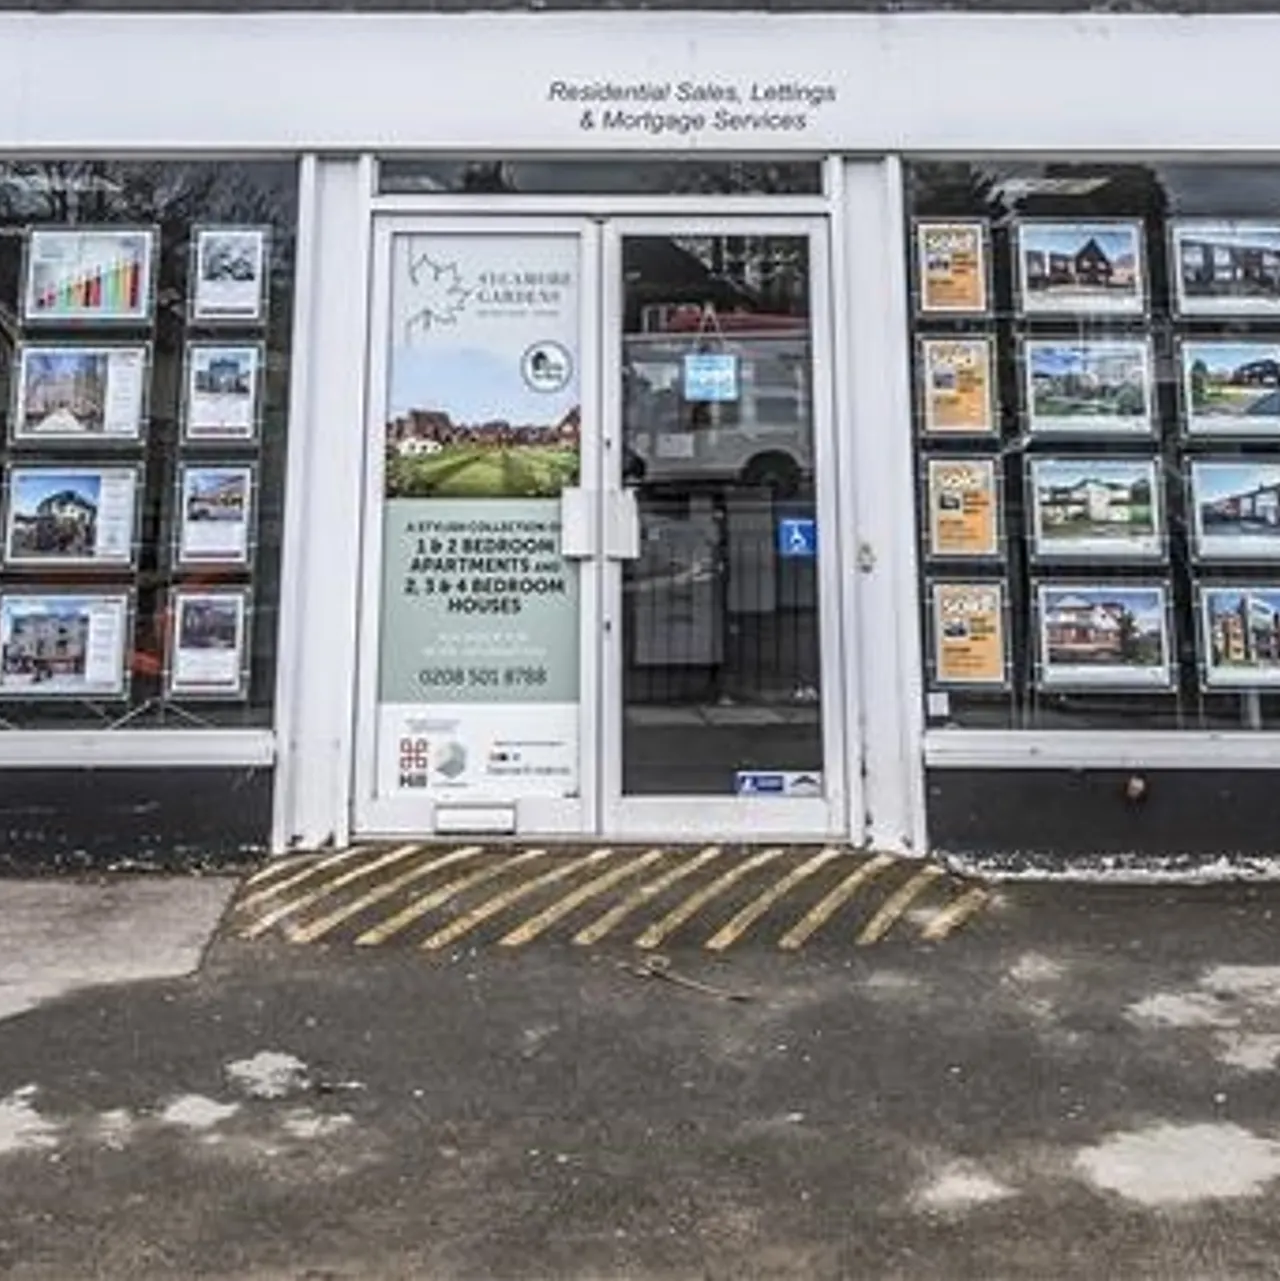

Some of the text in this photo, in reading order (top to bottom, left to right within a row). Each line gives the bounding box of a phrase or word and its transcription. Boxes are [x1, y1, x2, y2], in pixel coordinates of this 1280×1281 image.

[548, 80, 837, 106] Residential Sales, Lettings
[580, 109, 807, 134] & Mortgage Services
[462, 538, 556, 554] BEDROOM
[410, 557, 530, 573] APARTMENTS
[471, 577, 565, 594] BEDROOM
[448, 597, 522, 614] HOUSES
